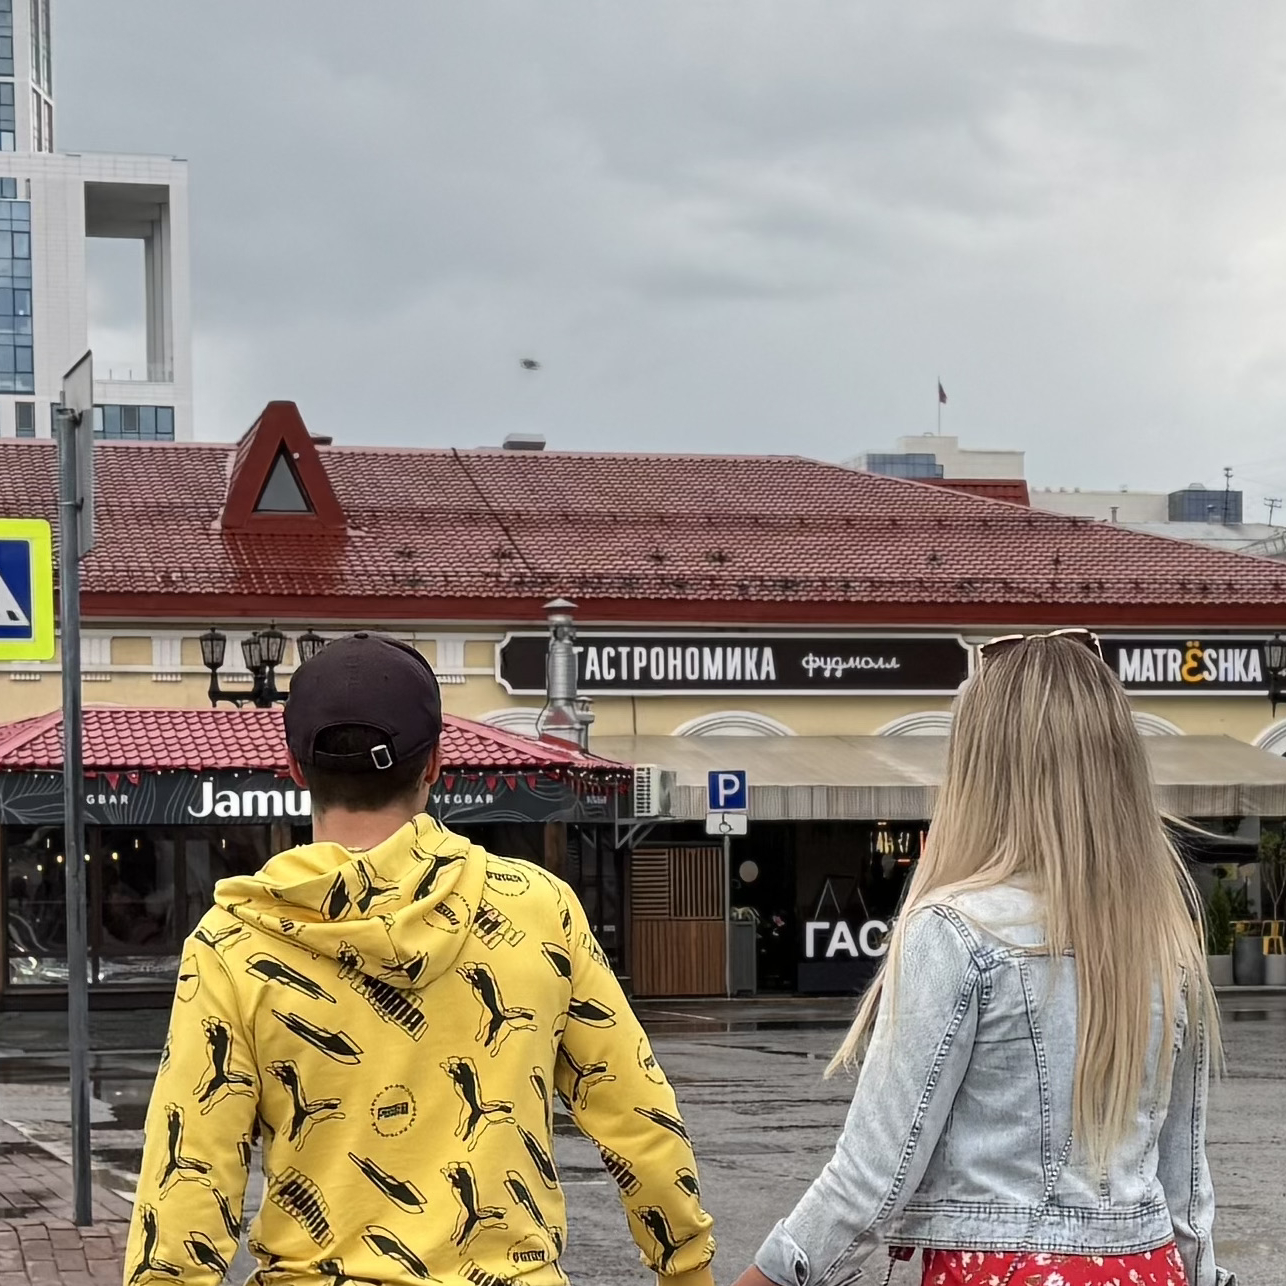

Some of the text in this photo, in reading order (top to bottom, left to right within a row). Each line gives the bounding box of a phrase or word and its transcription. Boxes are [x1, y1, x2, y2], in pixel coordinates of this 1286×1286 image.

[801, 652, 901, 678] фудмолл
[85, 794, 129, 805] GBAR
[188, 782, 312, 818] Jamu
[719, 774, 740, 806] P
[805, 919, 890, 958] ГАС
